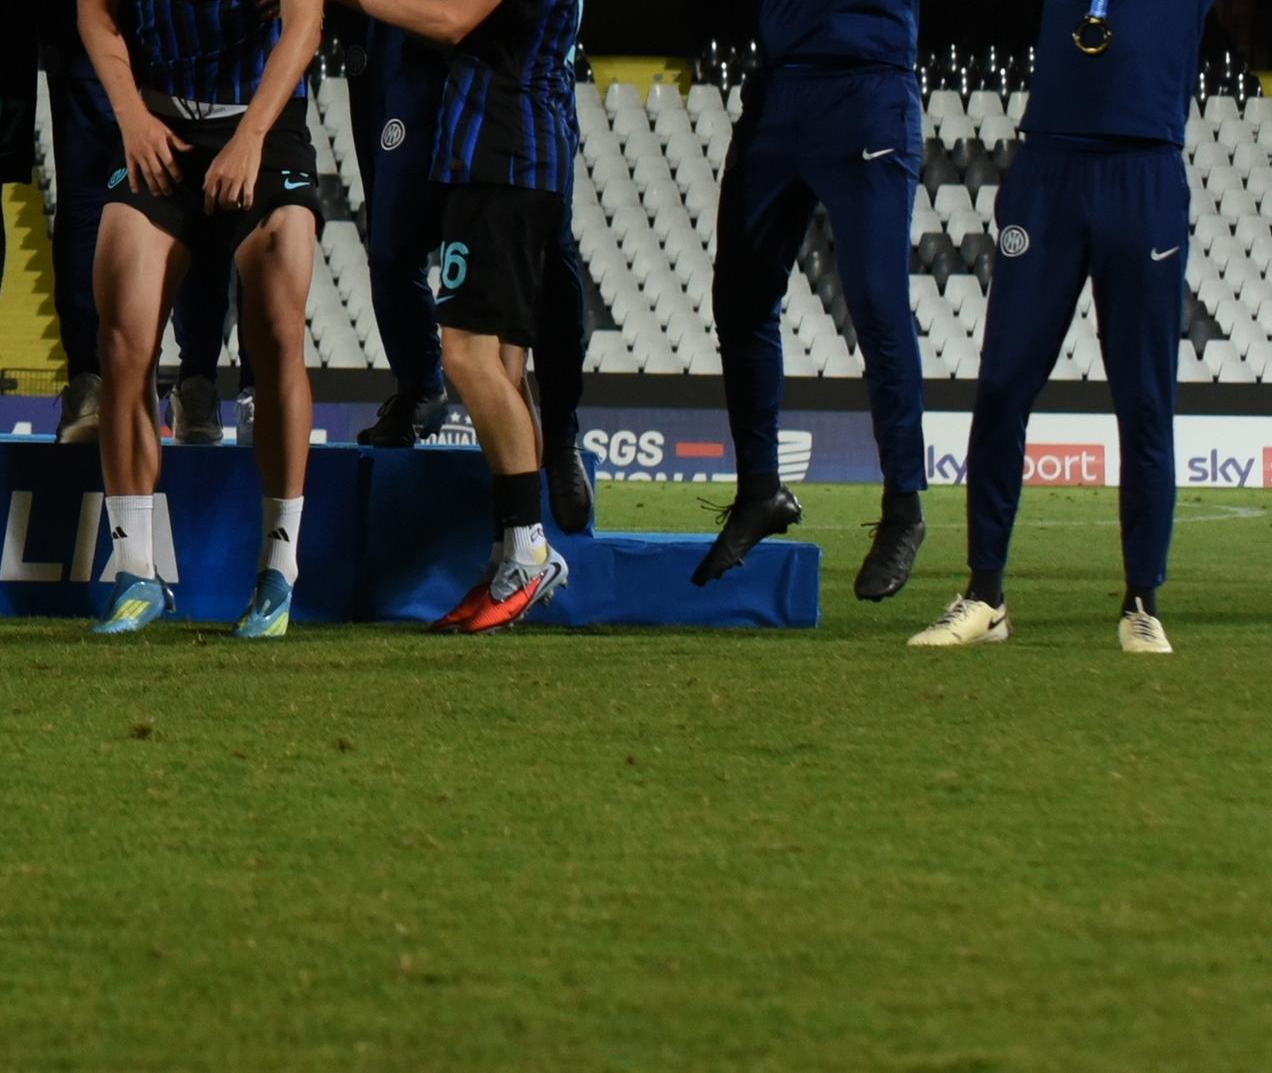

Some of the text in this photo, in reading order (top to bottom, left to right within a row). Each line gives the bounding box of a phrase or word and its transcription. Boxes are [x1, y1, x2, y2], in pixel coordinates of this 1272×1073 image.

[582, 428, 665, 467] SGS
[927, 444, 1097, 486] ky ort
[1187, 448, 1255, 488] sky
